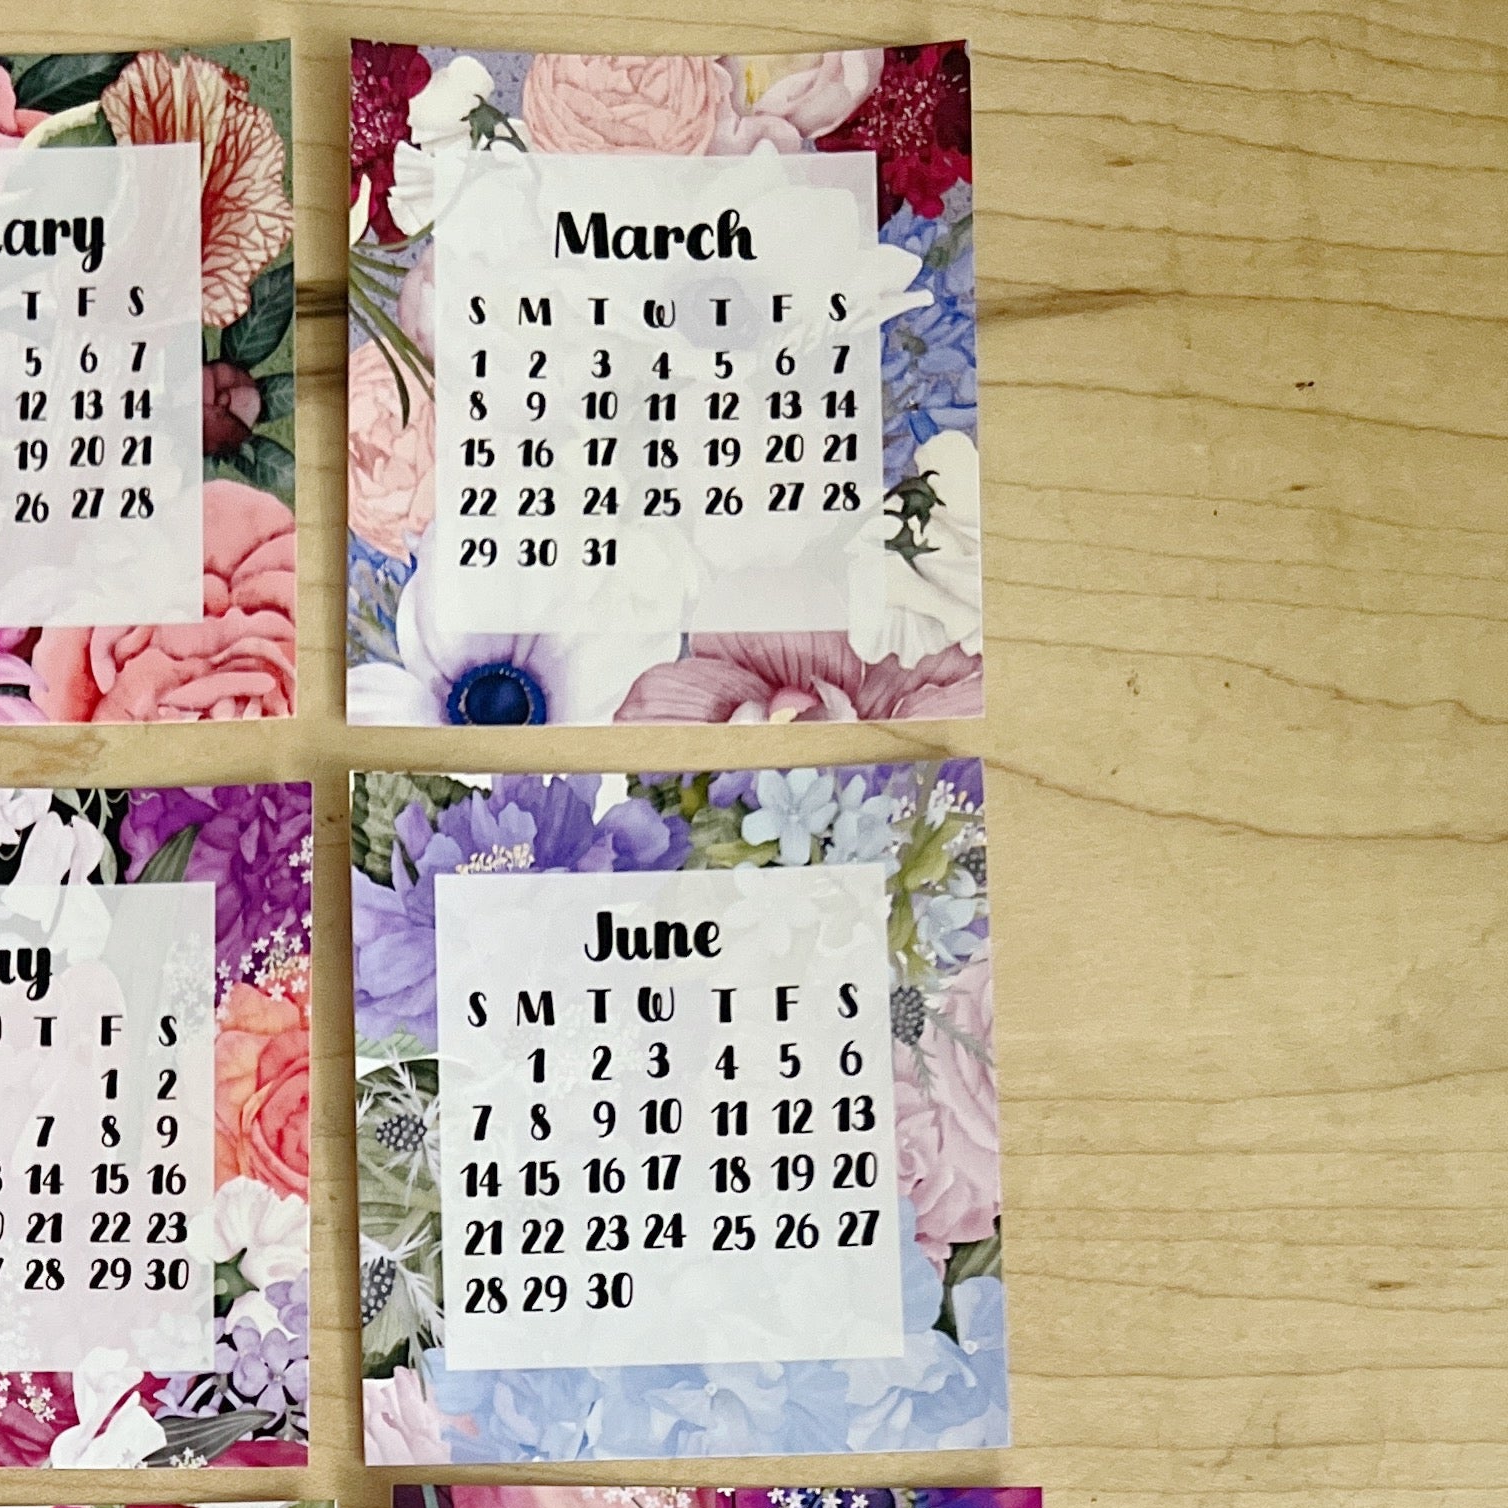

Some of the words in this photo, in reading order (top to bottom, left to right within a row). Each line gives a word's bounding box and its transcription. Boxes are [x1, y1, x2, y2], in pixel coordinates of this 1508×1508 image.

[554, 208, 758, 261] March
[22, 291, 40, 321] T
[77, 286, 96, 318] F
[128, 285, 145, 317] S
[468, 295, 486, 325] S
[518, 297, 552, 327] M
[588, 297, 609, 326] T
[643, 299, 676, 329] W
[709, 298, 731, 327] T
[772, 294, 793, 323] F
[828, 292, 847, 322] S
[15, 390, 47, 421] 12
[71, 389, 104, 421] 13
[120, 388, 152, 420] 14
[459, 537, 498, 567] 29
[518, 538, 558, 567] 30
[583, 538, 617, 567] 31
[584, 911, 722, 962] June
[467, 991, 487, 1028] S
[516, 990, 556, 1027] M
[586, 988, 612, 1024] T
[637, 986, 675, 1023] W
[711, 987, 737, 1024] T
[775, 985, 800, 1022] F
[837, 982, 859, 1019] S
[34, 1016, 58, 1047] T
[100, 1014, 123, 1047] F
[158, 1015, 178, 1047] S
[527, 1047, 546, 1084] 1
[591, 1045, 612, 1081] 2
[646, 1041, 670, 1079] 3
[714, 1044, 740, 1081] 4
[779, 1042, 801, 1079] 5
[839, 1040, 863, 1077] 6
[101, 1068, 118, 1100] 1
[156, 1068, 177, 1101] 2
[464, 1276, 508, 1314] 28
[522, 1274, 568, 1313] 29
[586, 1272, 634, 1310] 30
